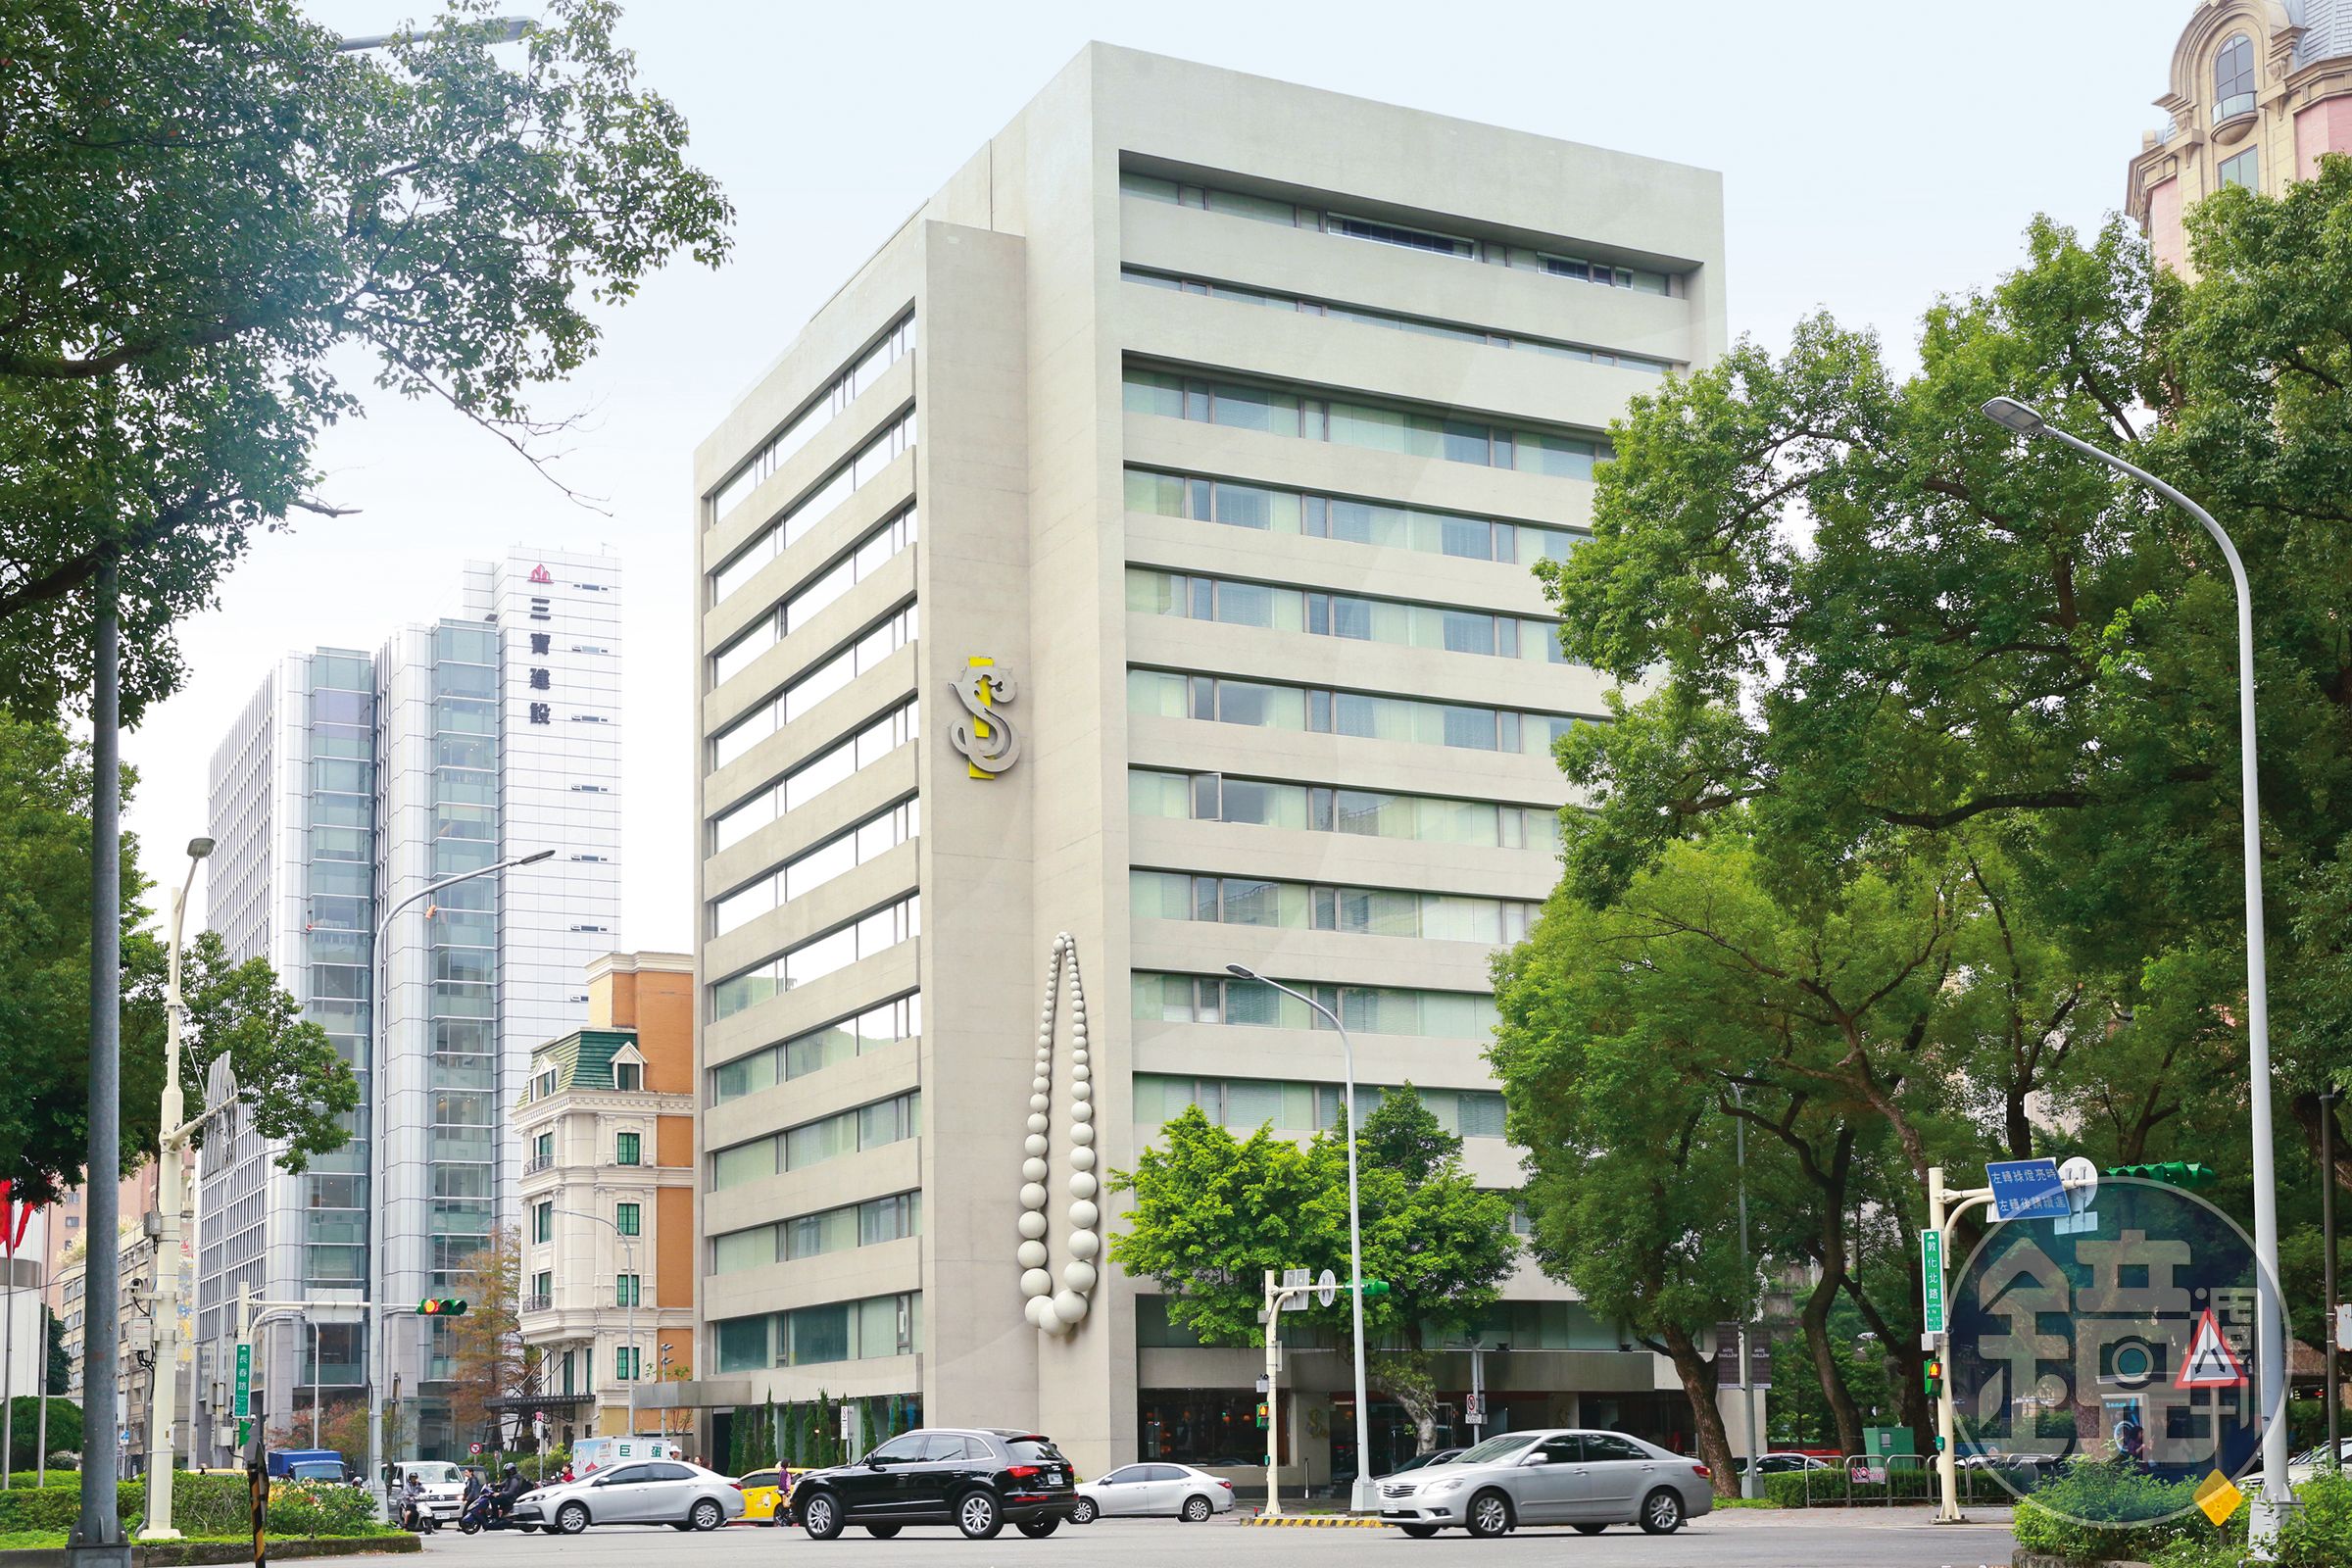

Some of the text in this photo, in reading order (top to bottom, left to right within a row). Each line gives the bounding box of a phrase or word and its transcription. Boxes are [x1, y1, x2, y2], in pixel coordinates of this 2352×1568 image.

[529, 597, 552, 726] 三寶建設
[1927, 1241, 1938, 1299] 敦化北路
[237, 1353, 248, 1391] 長春路
